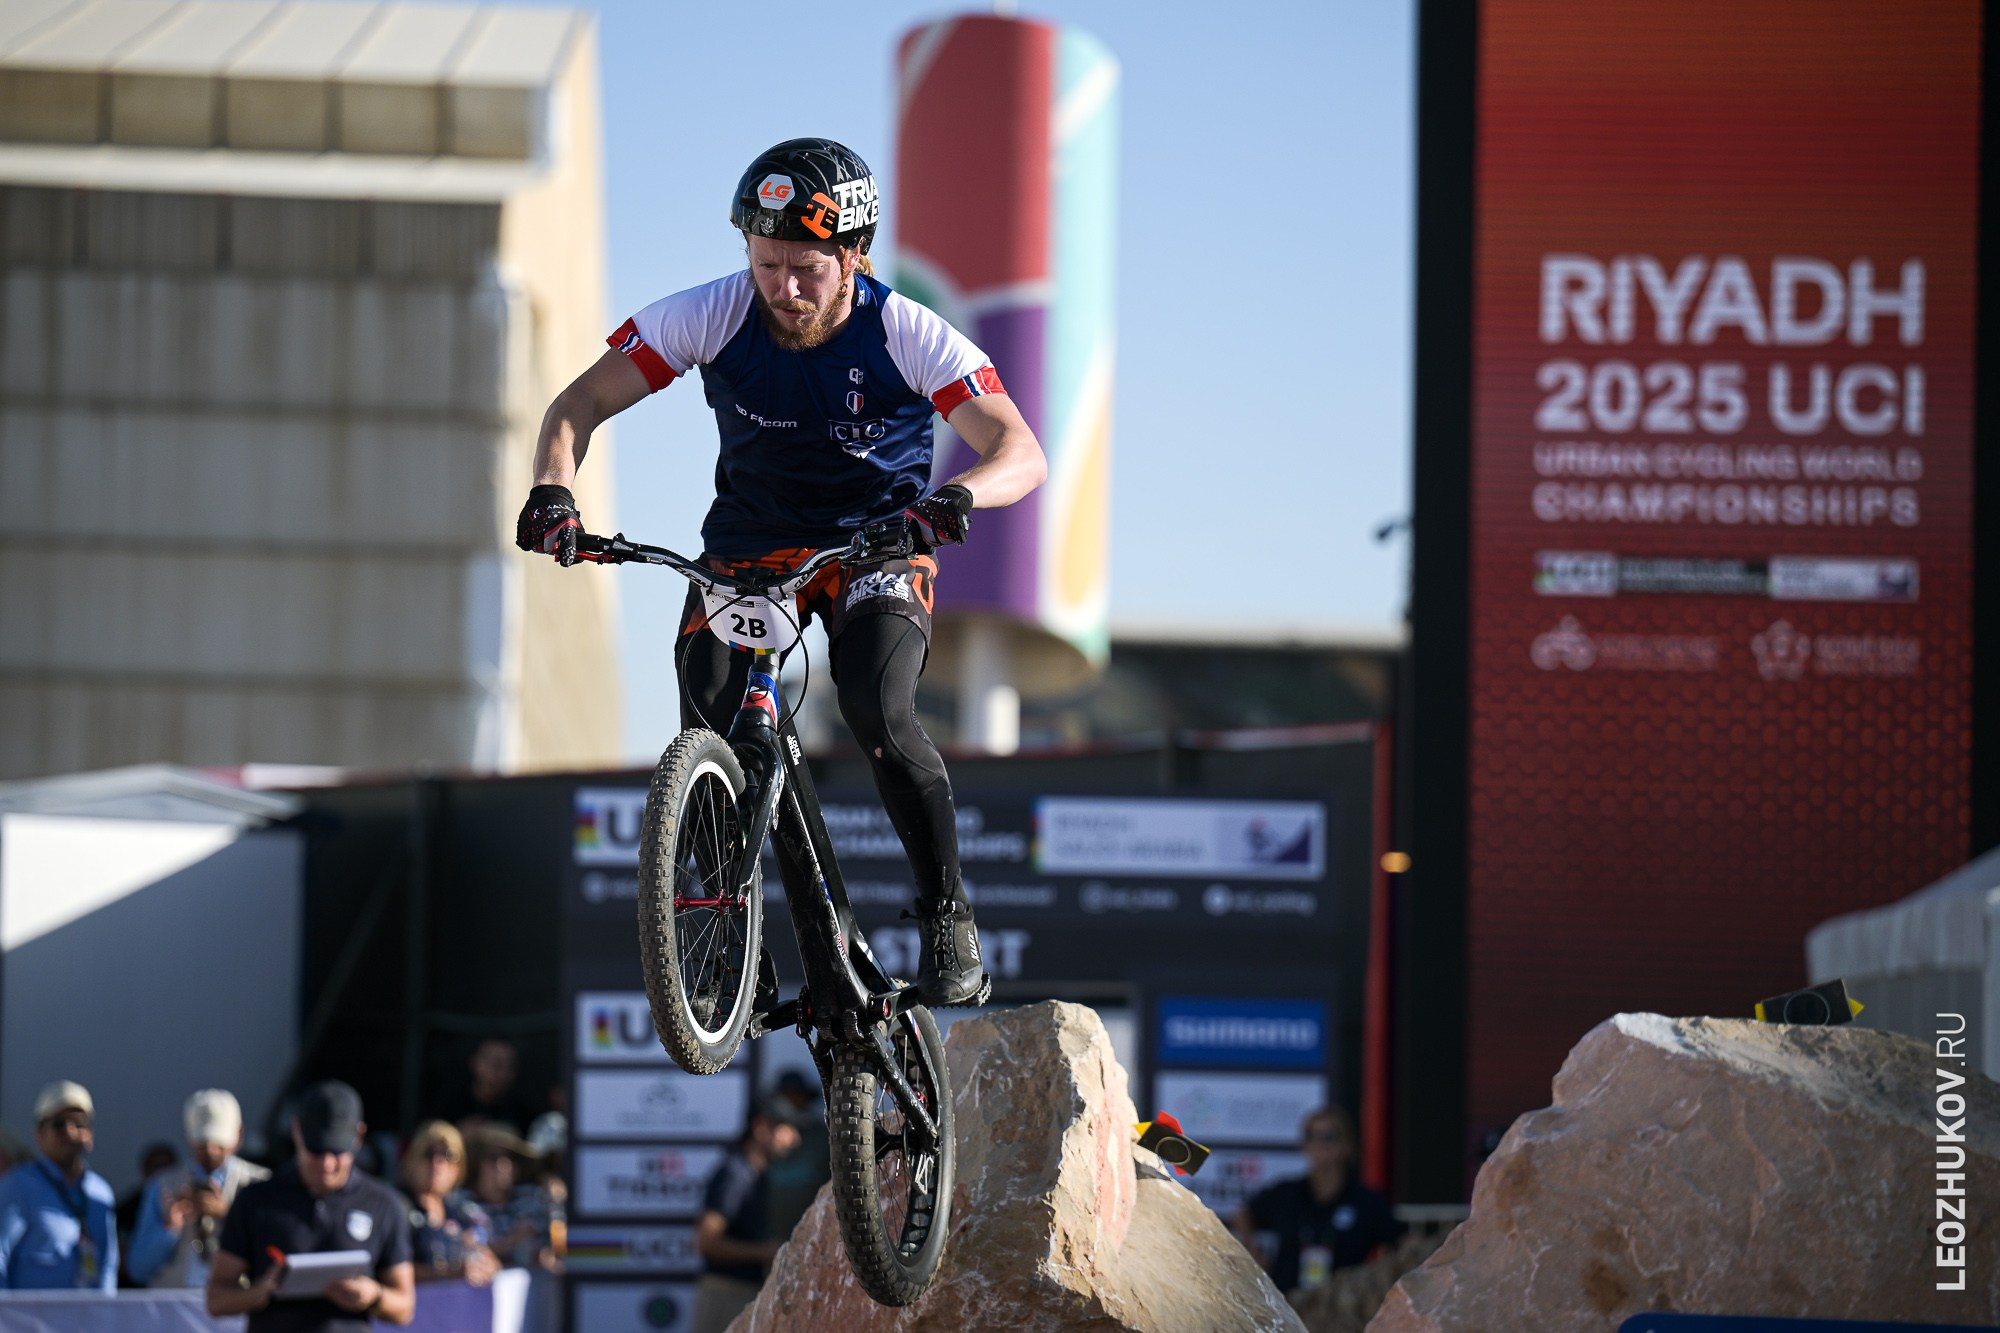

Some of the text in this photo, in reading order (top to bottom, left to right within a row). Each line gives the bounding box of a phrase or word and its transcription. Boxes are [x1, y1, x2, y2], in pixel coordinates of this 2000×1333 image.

[760, 181, 792, 198] LG
[1540, 255, 1925, 345] RIYADH
[1536, 360, 1925, 434] 2025 UCI
[1534, 444, 1921, 481] URBAN CYCLING WORLD
[1533, 482, 1919, 525] CHAMPIONSHIPS
[846, 581, 909, 608] BIKES
[730, 613, 767, 638] 2B
[871, 928, 1028, 978] STRT
